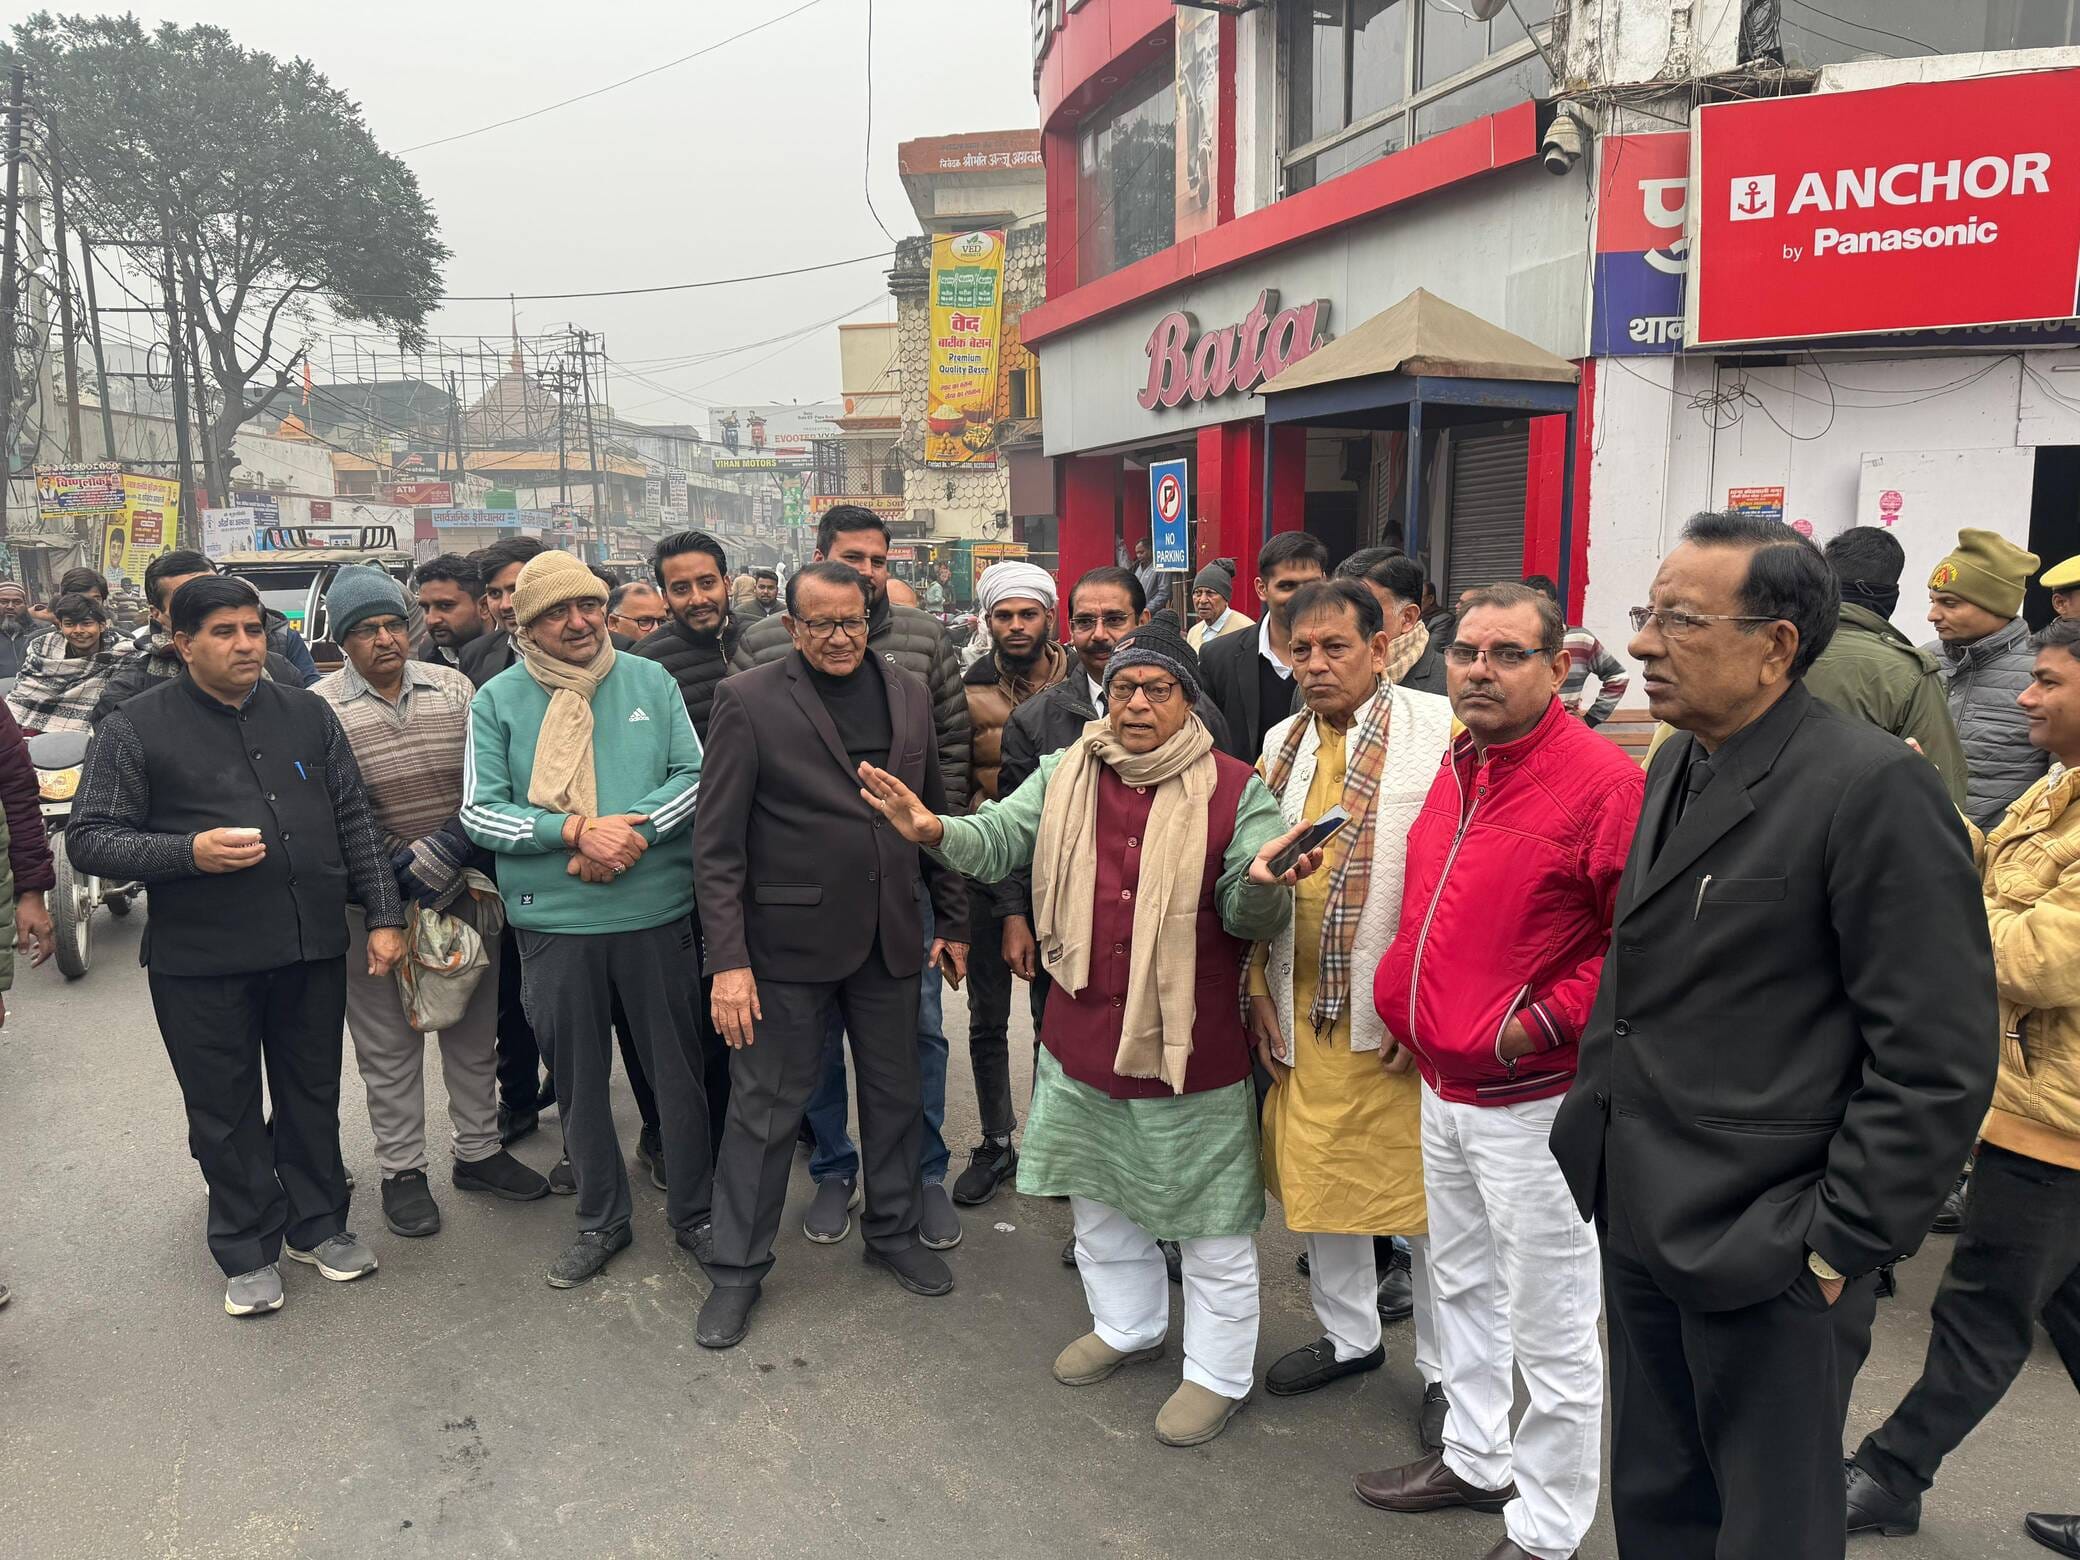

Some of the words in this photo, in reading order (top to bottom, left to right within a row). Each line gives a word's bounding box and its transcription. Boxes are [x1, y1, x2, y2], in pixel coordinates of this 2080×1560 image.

[1787, 152, 2052, 215] ANCHOR
[1782, 243, 1803, 263] by
[1813, 216, 1998, 257] Panasonic
[962, 245, 982, 253] VED
[951, 312, 981, 333] वेद
[1136, 288, 1328, 411] Bata
[948, 353, 981, 362] Premium
[939, 365, 966, 375] Quality
[715, 460, 740, 468] VIHAN
[743, 459, 777, 468] MOTORS
[396, 485, 416, 493] ATM
[434, 511, 470, 523] सार्वजनिक
[472, 510, 505, 523] शौचालय
[1165, 532, 1175, 545] NO
[1156, 550, 1185, 562] PARKING
